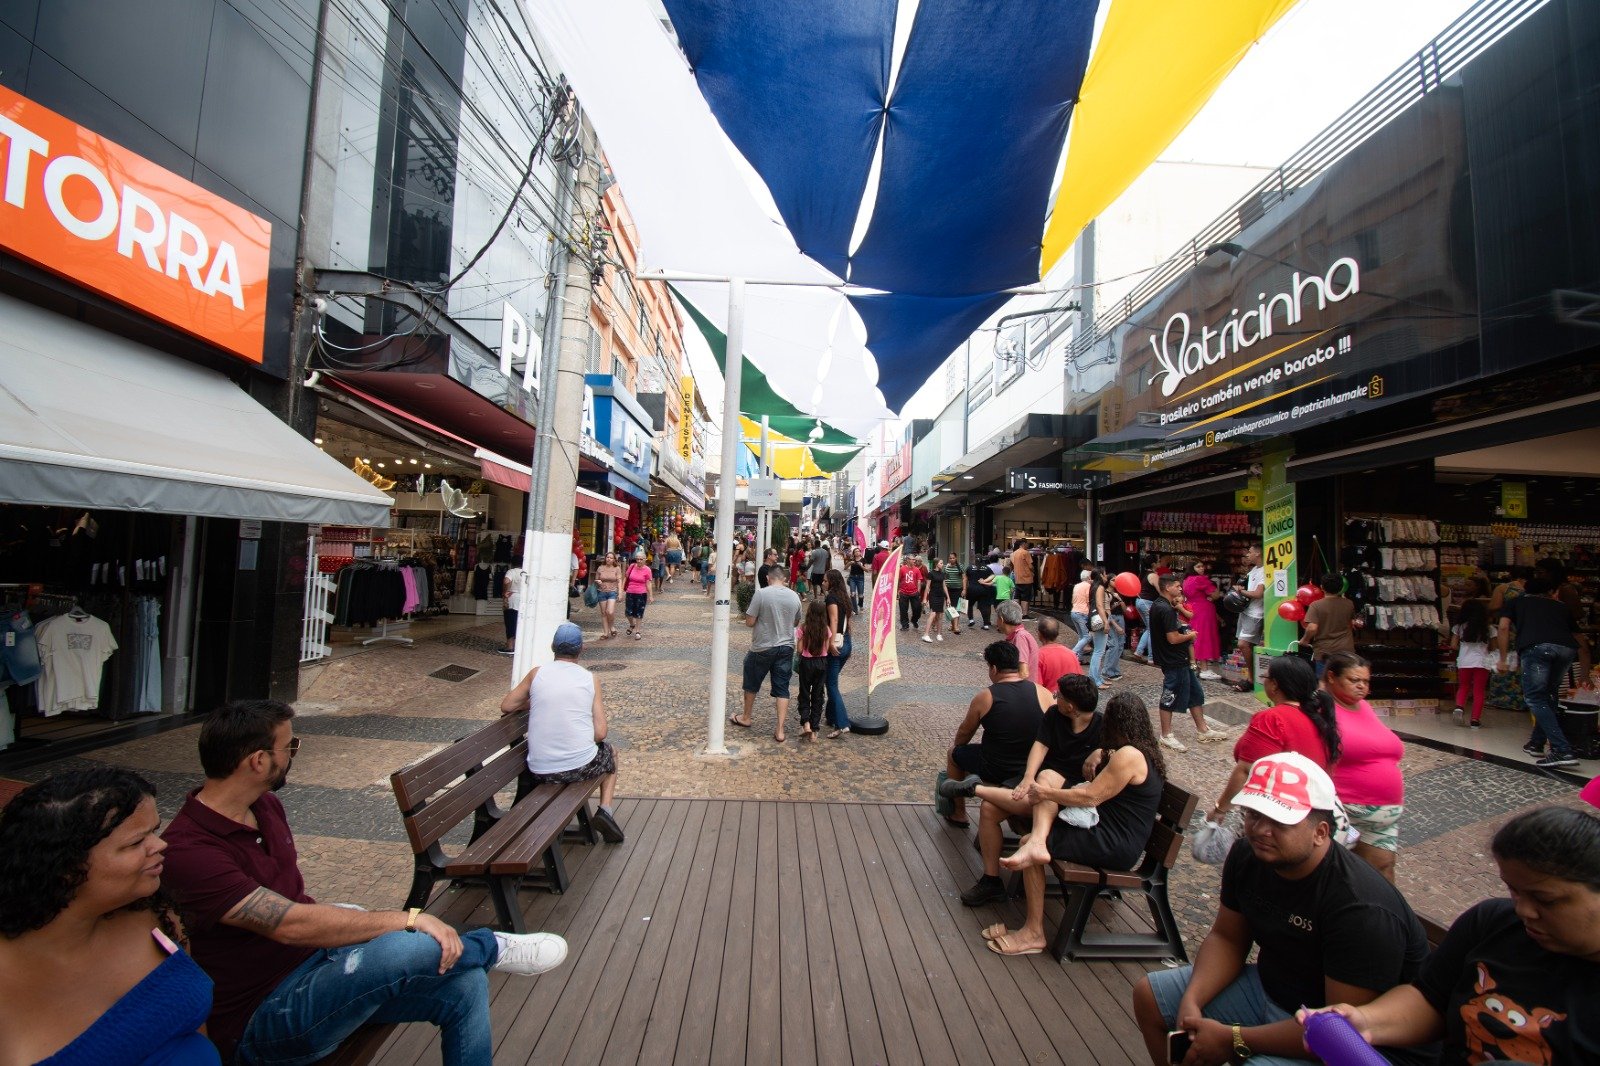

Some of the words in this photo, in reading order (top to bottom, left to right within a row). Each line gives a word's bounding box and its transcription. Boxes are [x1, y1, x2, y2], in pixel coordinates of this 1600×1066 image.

[0, 113, 245, 311] TORRA
[1149, 257, 1360, 397] Patricinha
[1160, 401, 1200, 426] Brasileiro
[1201, 382, 1243, 410] também
[1244, 367, 1282, 393] vende
[1284, 344, 1336, 377] barato
[1291, 386, 1369, 418] @patricinhamake
[682, 393, 691, 458] DENTISTAS
[1267, 506, 1293, 523] PREÇO
[1267, 517, 1294, 535] ÚNICO
[1288, 913, 1313, 931] BOSS
